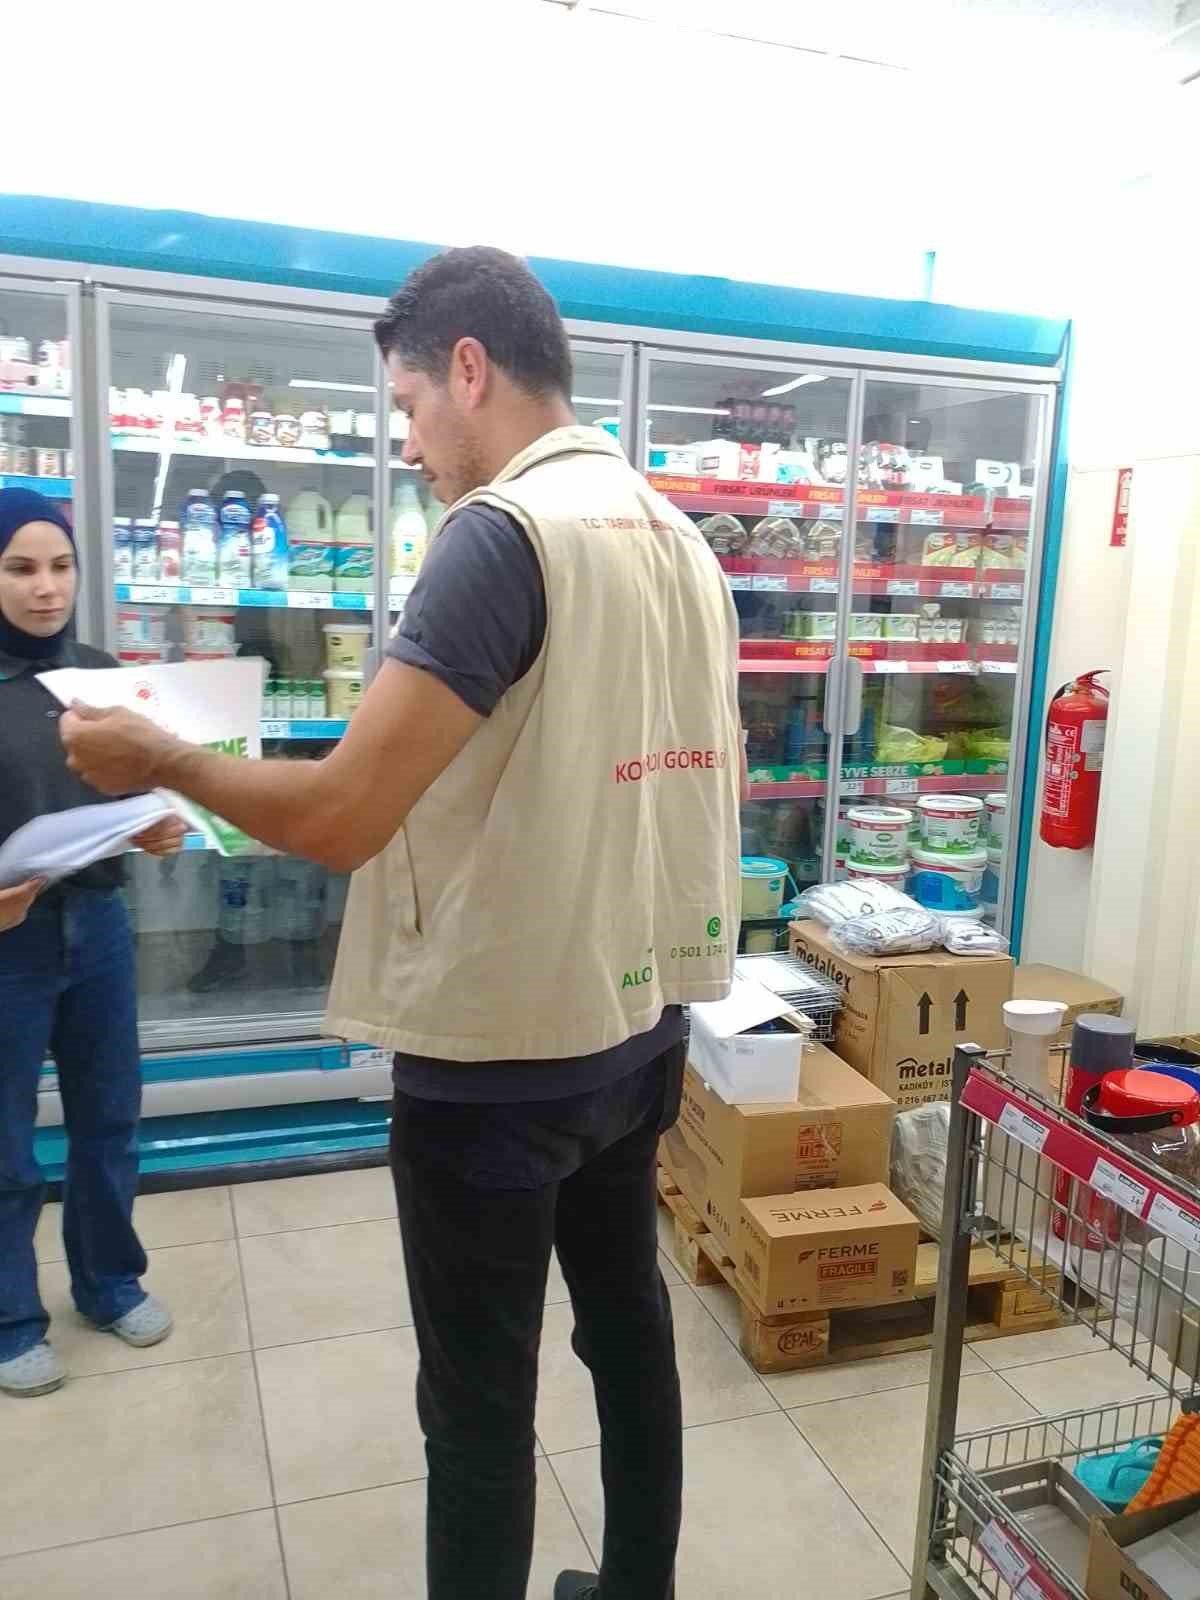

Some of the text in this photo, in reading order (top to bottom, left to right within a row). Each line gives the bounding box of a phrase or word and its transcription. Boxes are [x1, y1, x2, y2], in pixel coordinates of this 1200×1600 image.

[621, 966, 653, 989] ALO
[897, 1057, 951, 1079] metal
[773, 1205, 863, 1224] FERME
[818, 1242, 880, 1259] FERME
[821, 1261, 875, 1278] FRAGILE
